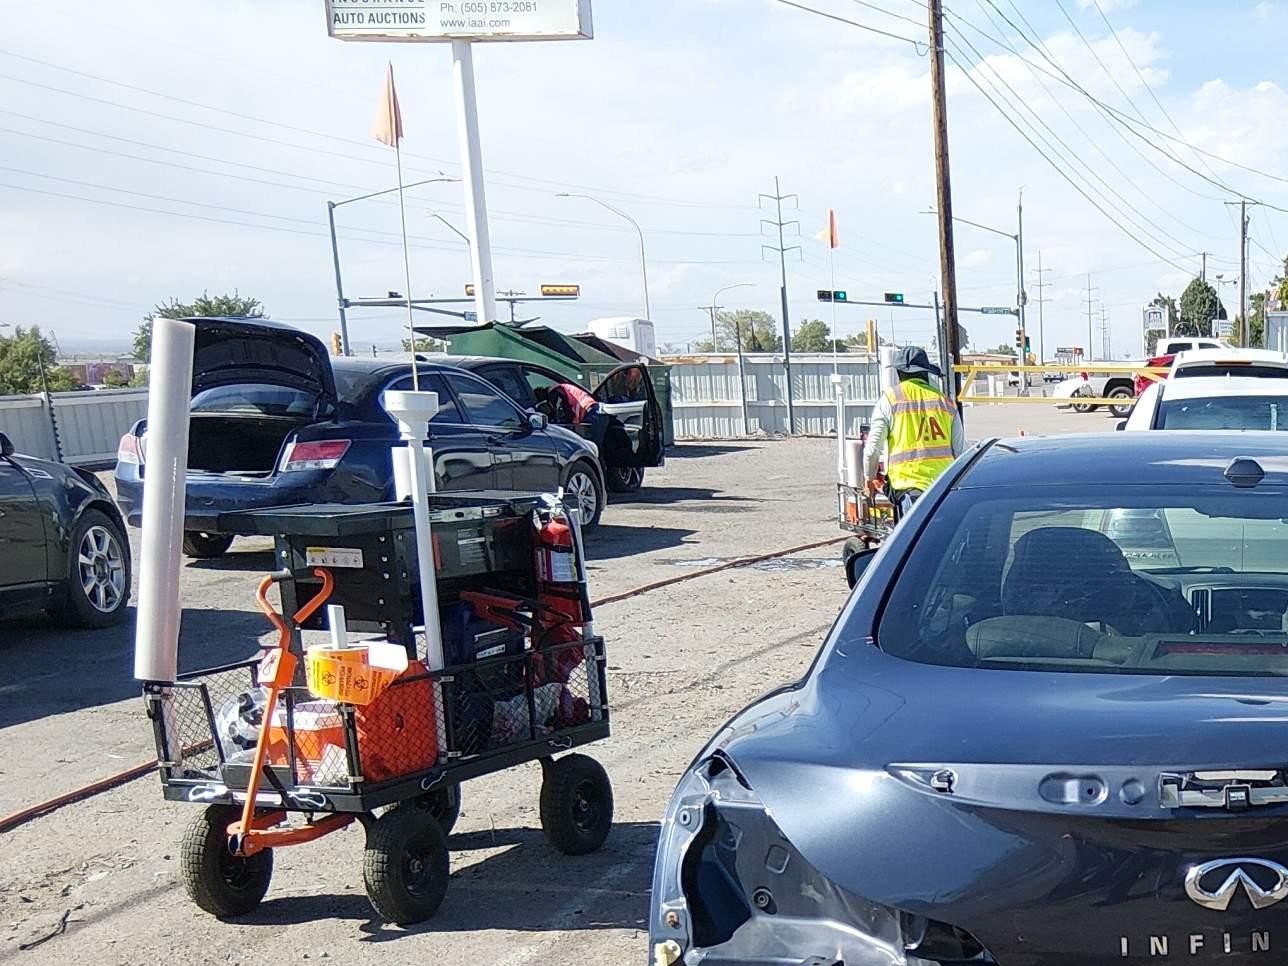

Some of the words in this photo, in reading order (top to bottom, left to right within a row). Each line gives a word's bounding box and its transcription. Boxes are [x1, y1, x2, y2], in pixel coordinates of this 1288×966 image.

[461, 2, 488, 15] (505)
[490, 1, 537, 13] 873-2081
[333, 12, 364, 25] AUTO
[367, 12, 426, 25] AUCTIONS
[440, 18, 511, 29] www.iaai.com
